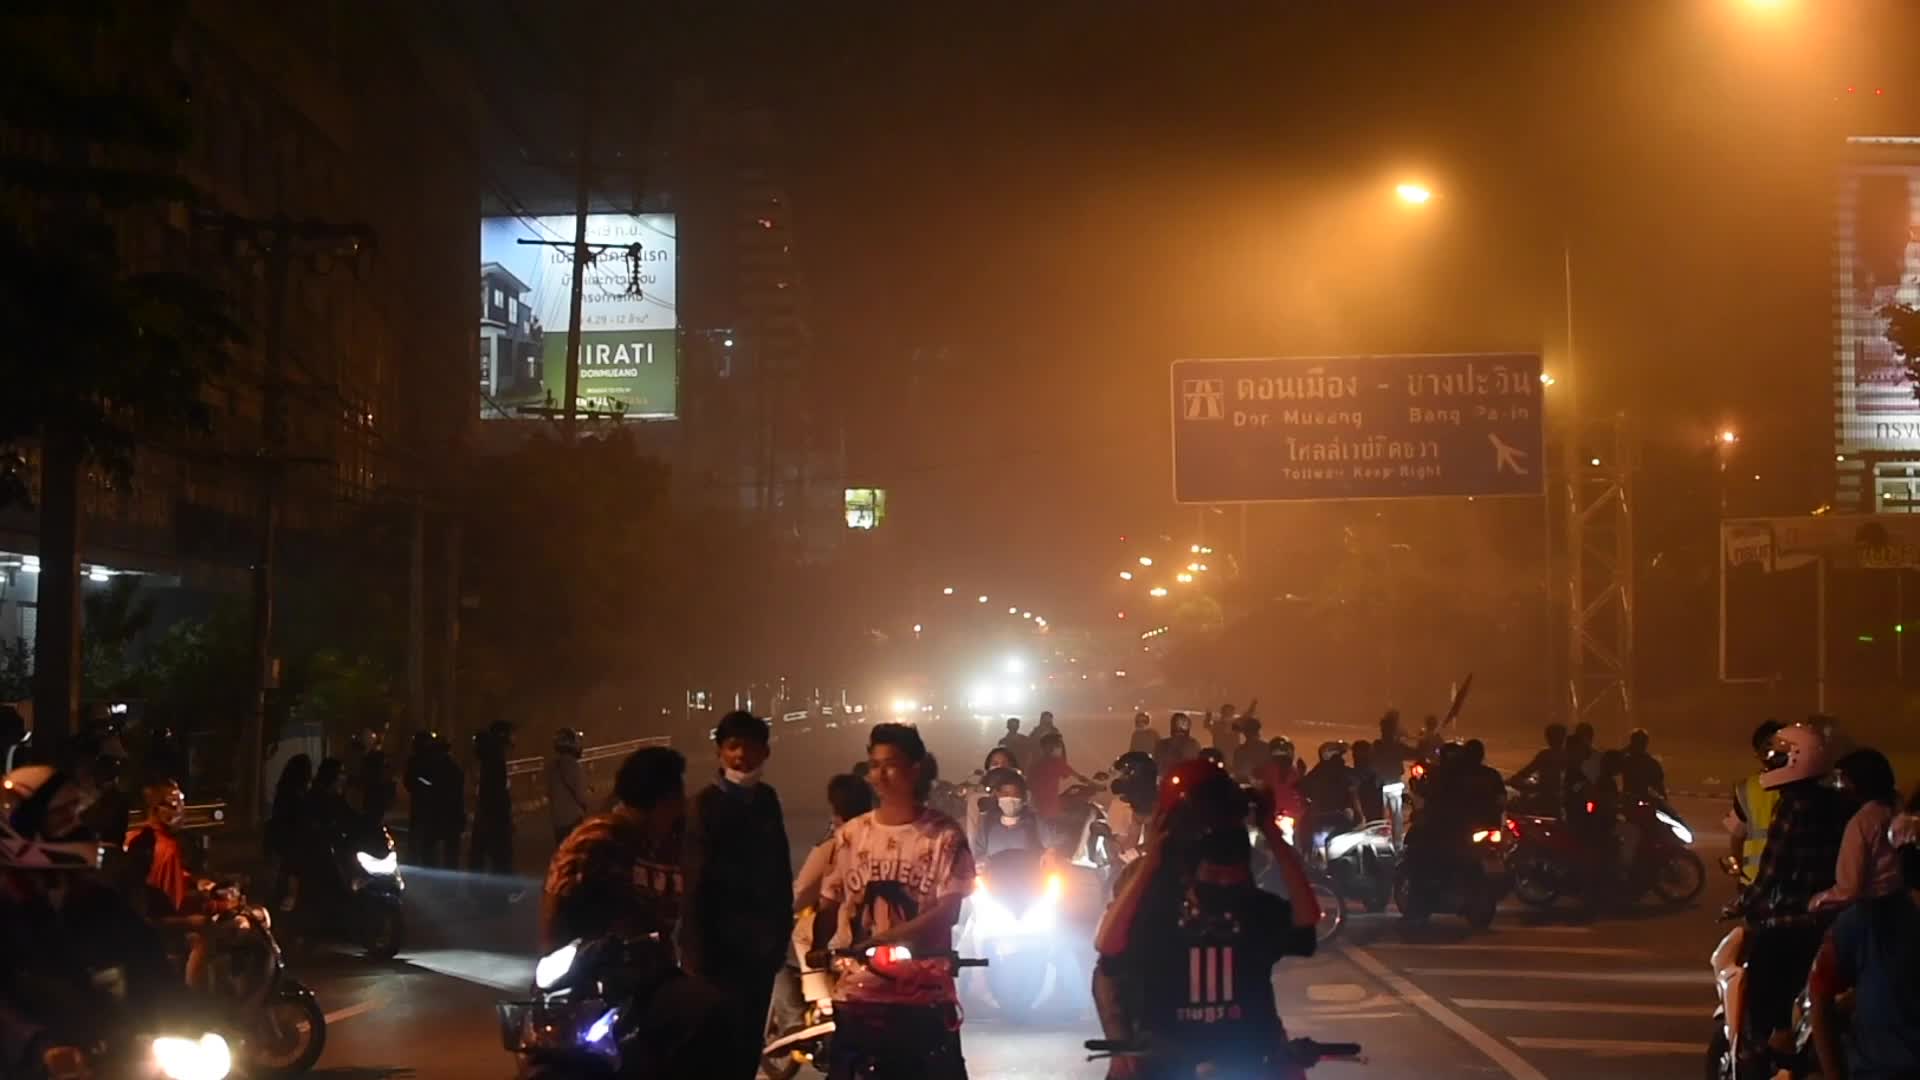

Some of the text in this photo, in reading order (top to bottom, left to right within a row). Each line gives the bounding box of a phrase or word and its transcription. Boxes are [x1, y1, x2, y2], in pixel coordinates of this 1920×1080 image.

[577, 343, 654, 365] IRATI
[1236, 368, 1359, 402] ดอนเมือง
[1408, 364, 1533, 397] บางปะอิน
[1409, 407, 1462, 426] Bang
